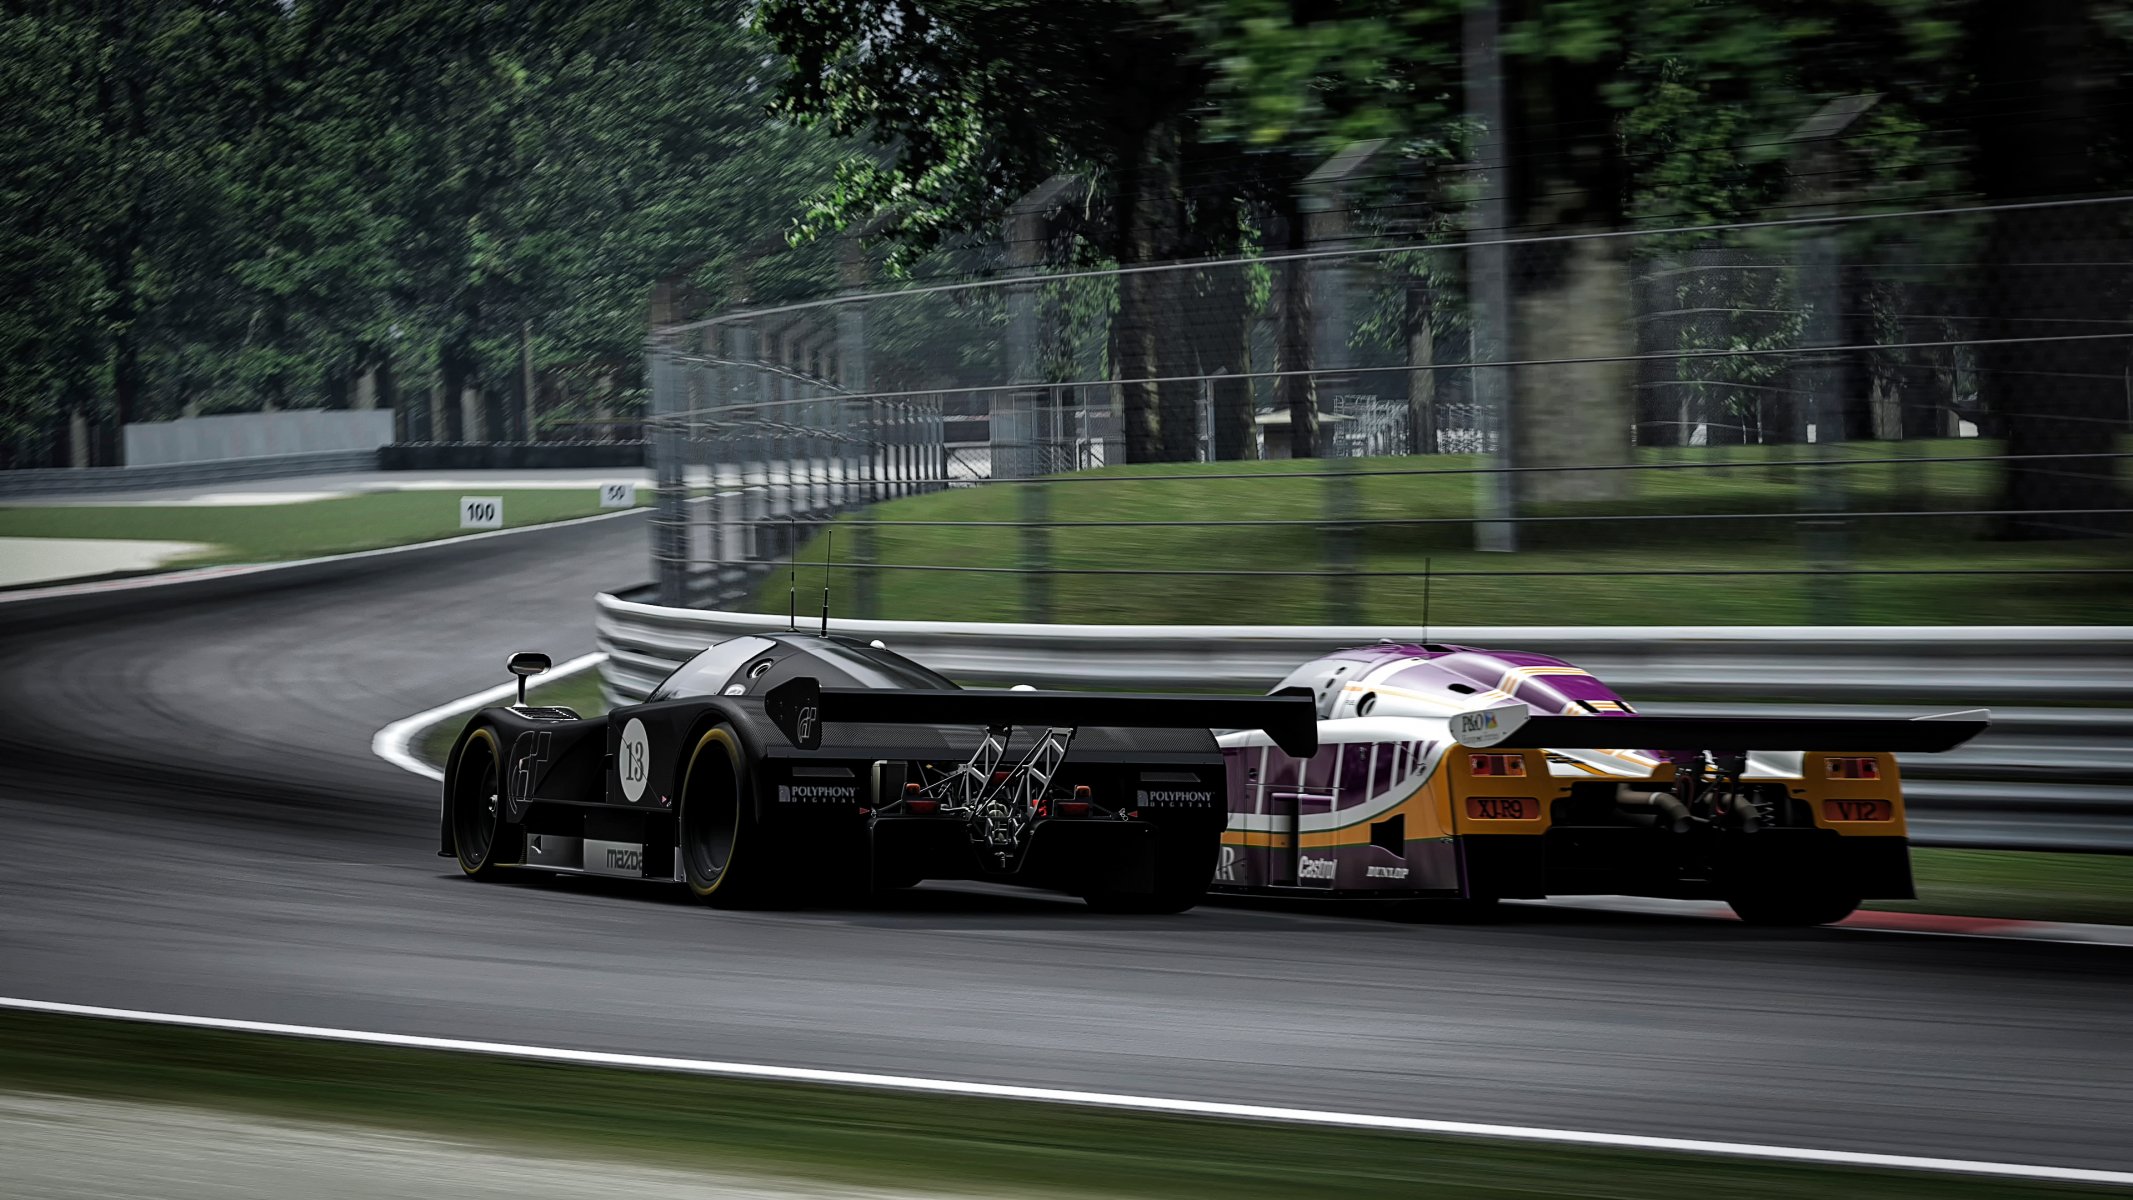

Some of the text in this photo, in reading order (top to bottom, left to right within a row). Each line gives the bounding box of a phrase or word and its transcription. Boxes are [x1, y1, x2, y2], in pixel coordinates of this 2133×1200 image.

[607, 485, 626, 501] 50
[467, 502, 496, 522] 100
[1462, 713, 1484, 733] P&O
[625, 741, 645, 782] 13
[792, 786, 856, 797] POLYPHONY
[1149, 791, 1212, 801] POLYPHONY
[1837, 801, 1877, 820] V12
[1298, 855, 1338, 880] Castrol
[1366, 865, 1410, 879] DUNLOP
